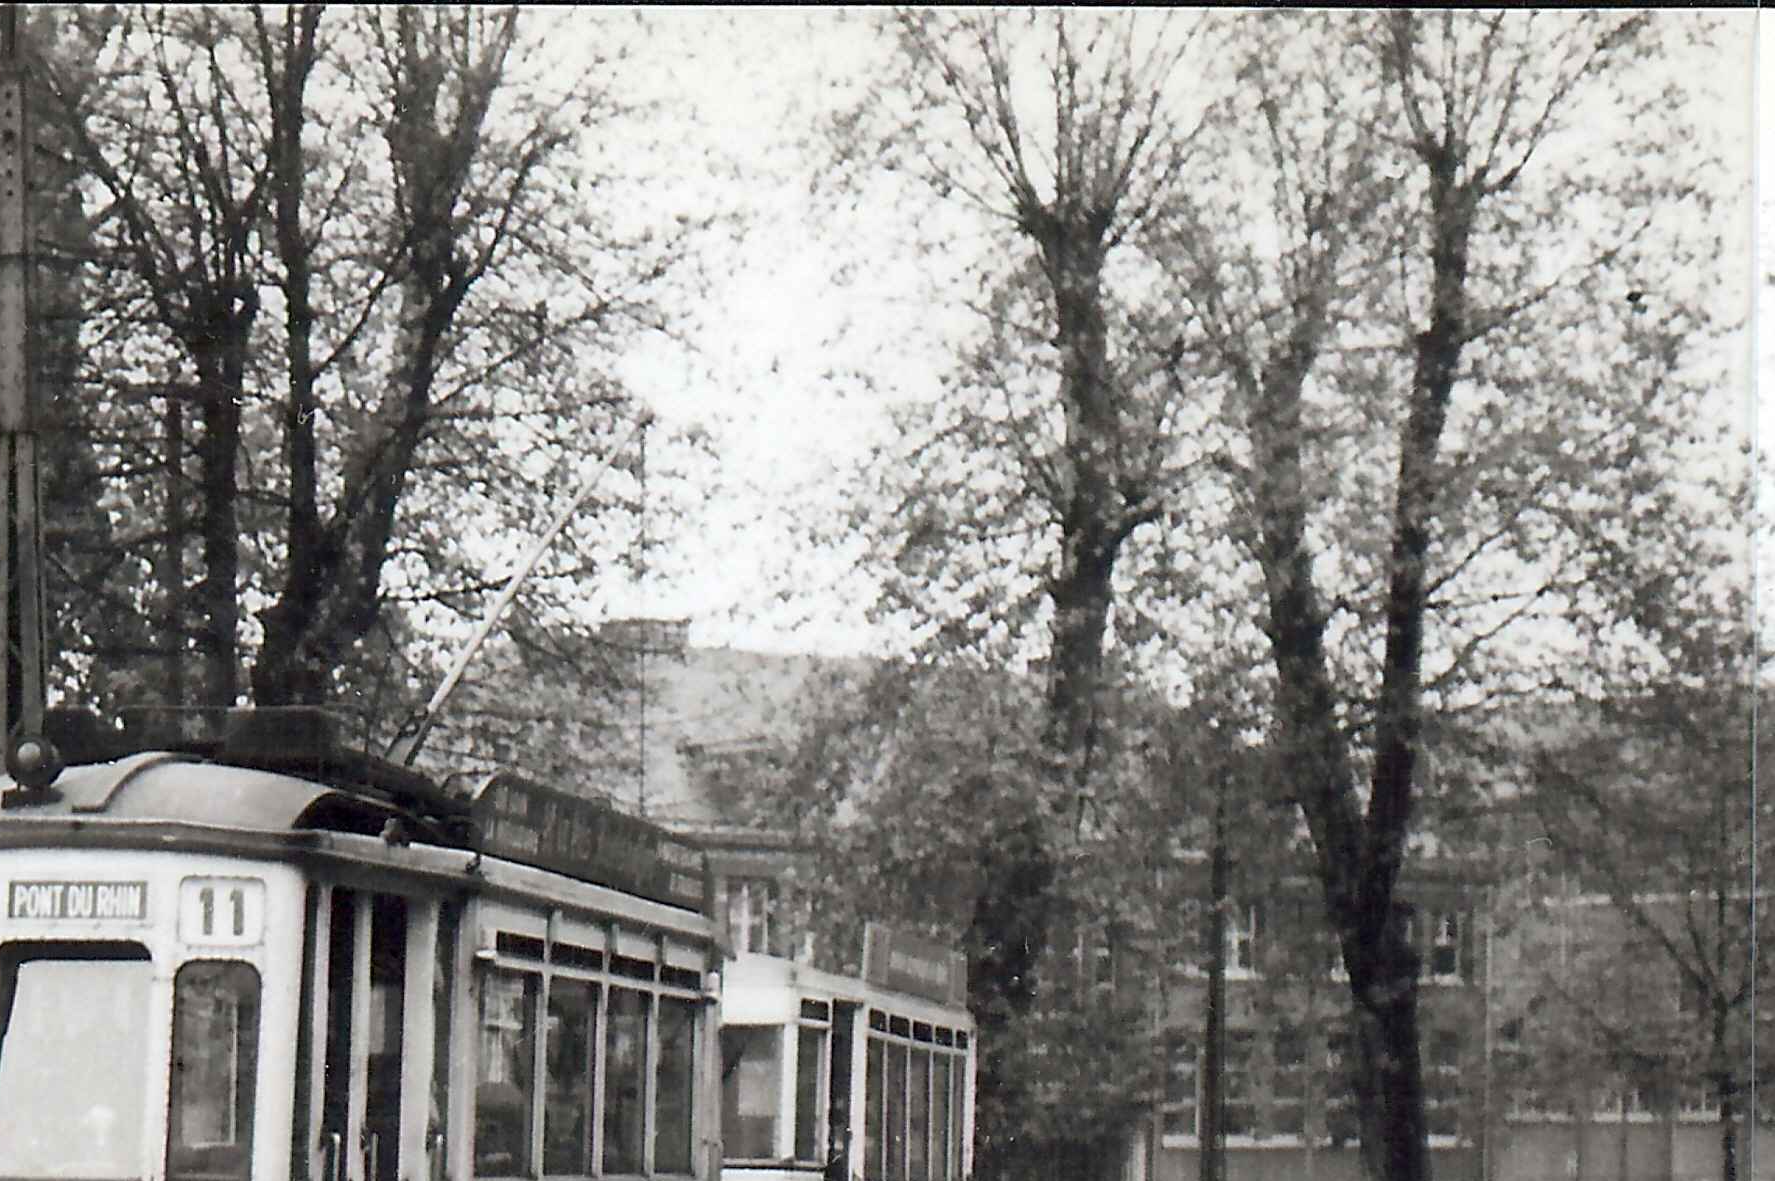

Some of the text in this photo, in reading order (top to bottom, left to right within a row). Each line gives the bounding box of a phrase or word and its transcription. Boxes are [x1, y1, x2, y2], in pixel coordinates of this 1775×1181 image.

[14, 883, 141, 918] PONT DU RHIN
[198, 886, 245, 936] 11
